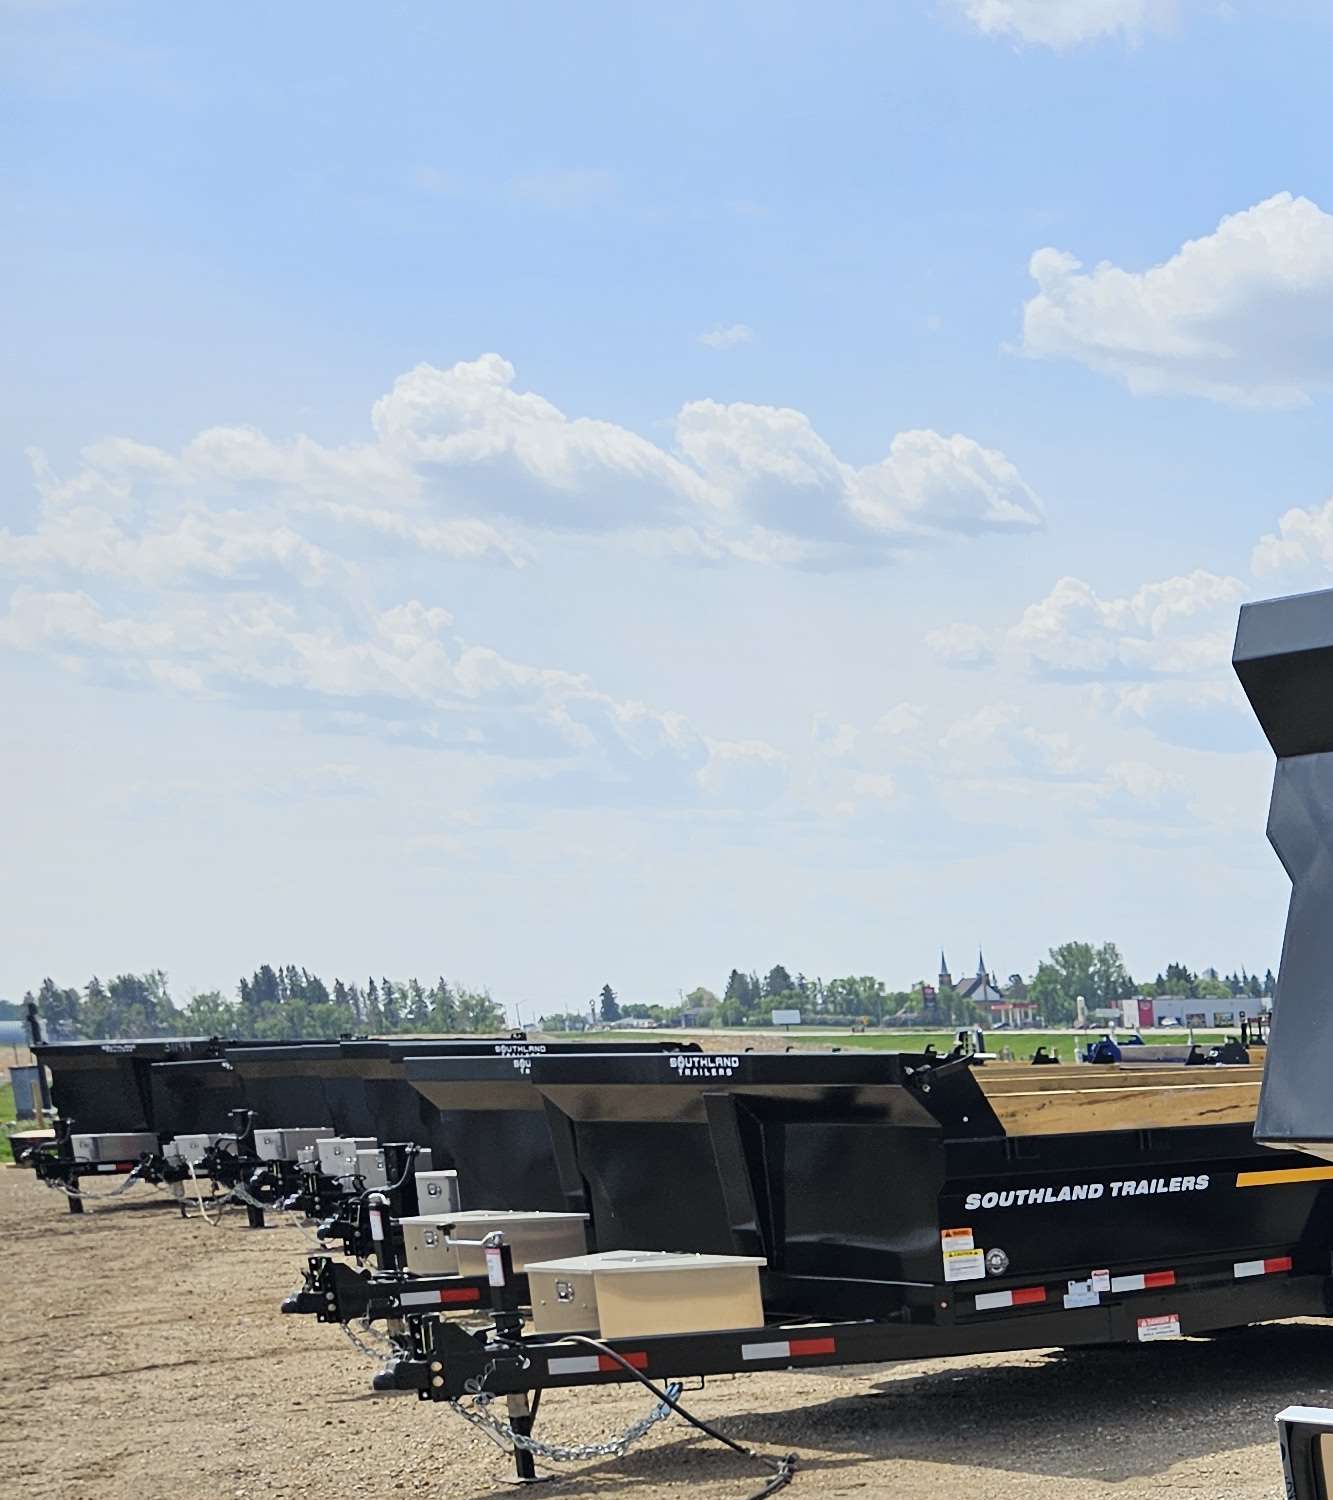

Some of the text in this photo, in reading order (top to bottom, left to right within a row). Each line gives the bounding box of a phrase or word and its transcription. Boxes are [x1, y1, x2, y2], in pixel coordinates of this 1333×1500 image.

[494, 1044, 546, 1054] SOUTHLAND
[669, 1056, 740, 1068] SOUTHLAND
[678, 1068, 733, 1076] TRAILERS
[964, 1175, 1210, 1210] SOUTHLAND TRAILERS
